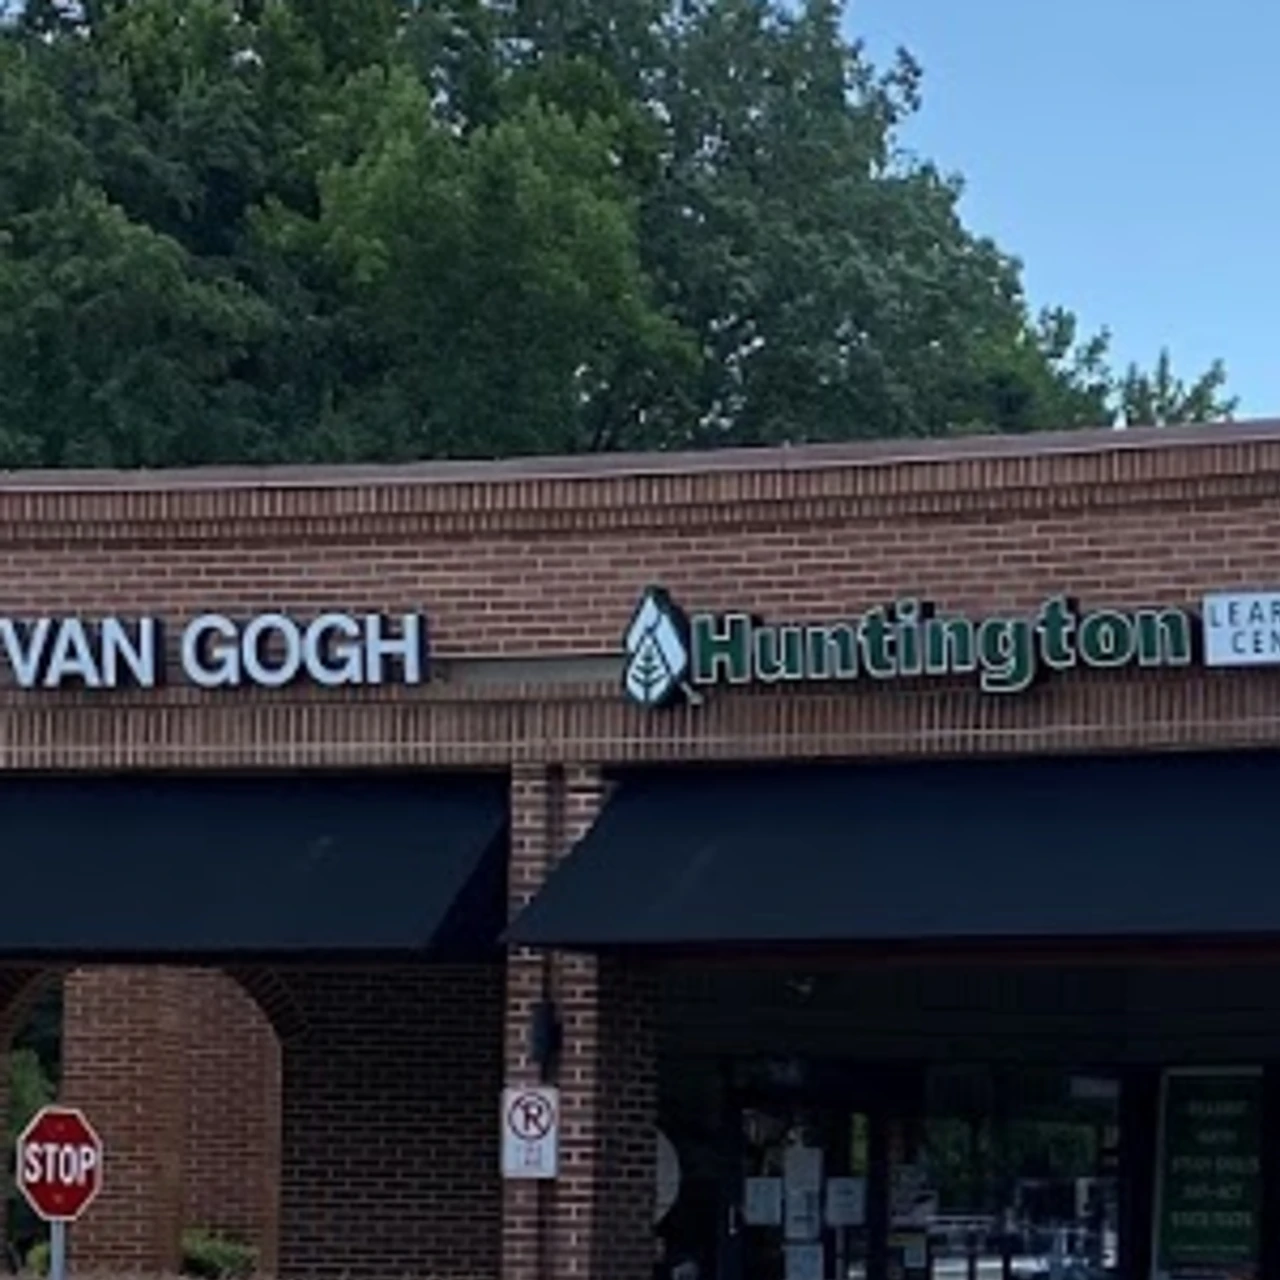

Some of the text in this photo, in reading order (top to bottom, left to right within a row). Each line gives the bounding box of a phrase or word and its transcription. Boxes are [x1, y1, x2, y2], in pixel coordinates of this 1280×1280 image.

[0, 612, 421, 687] VAN GOGH
[690, 596, 1192, 692] Huntington
[25, 1142, 96, 1186] STOP
